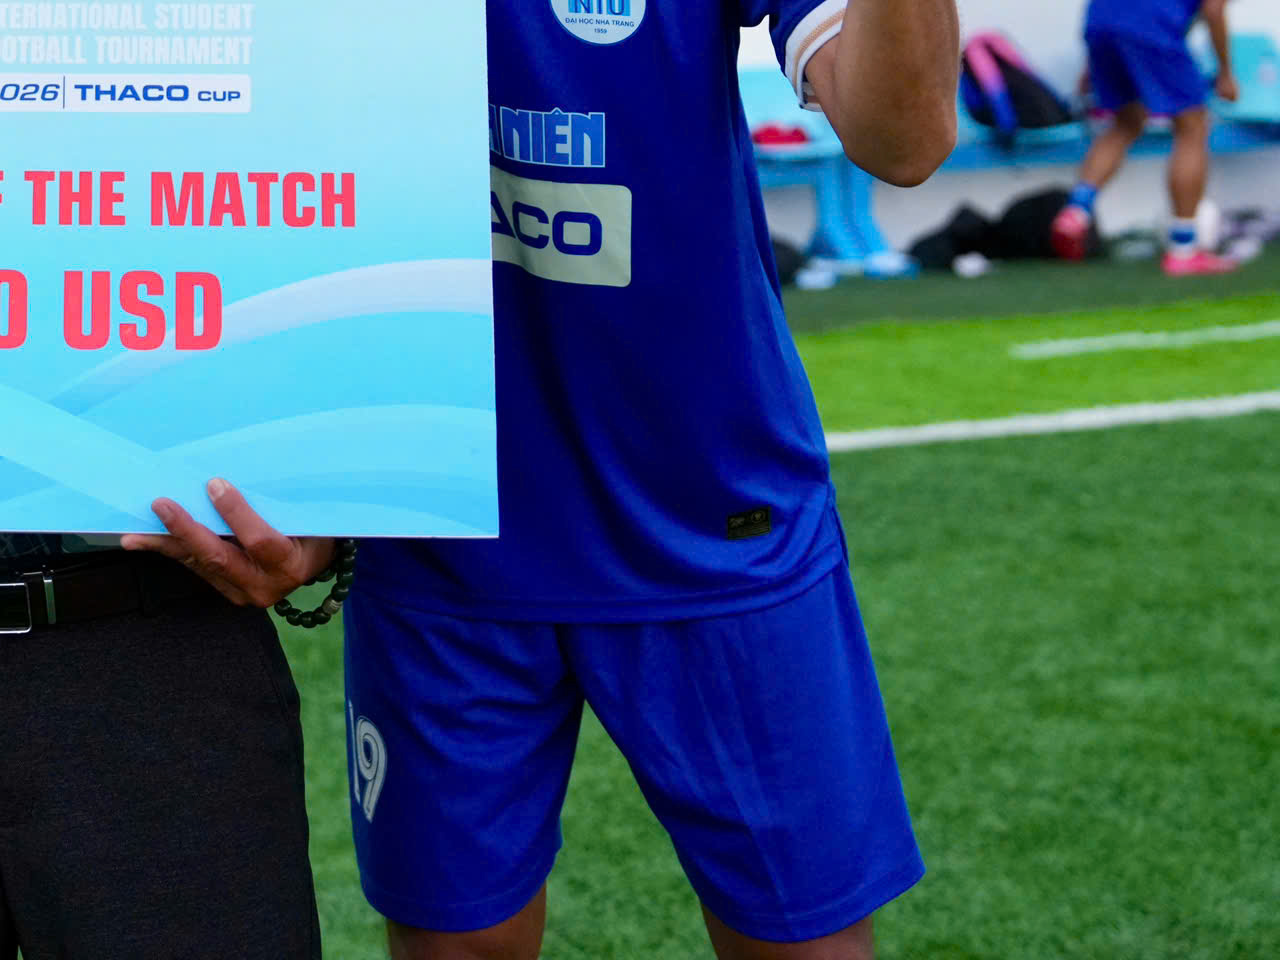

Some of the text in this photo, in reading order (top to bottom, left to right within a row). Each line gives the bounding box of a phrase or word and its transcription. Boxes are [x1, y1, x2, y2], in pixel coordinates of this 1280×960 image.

[155, 2, 254, 30] STUDENT
[611, 19, 635, 27] TRANG
[96, 35, 253, 65] TOURNAMENT
[74, 84, 190, 102] THACO
[197, 90, 242, 102] CUP
[500, 106, 606, 168] NIÊN
[24, 170, 126, 226] THE
[150, 171, 356, 228] MATCH
[63, 270, 223, 352] USD
